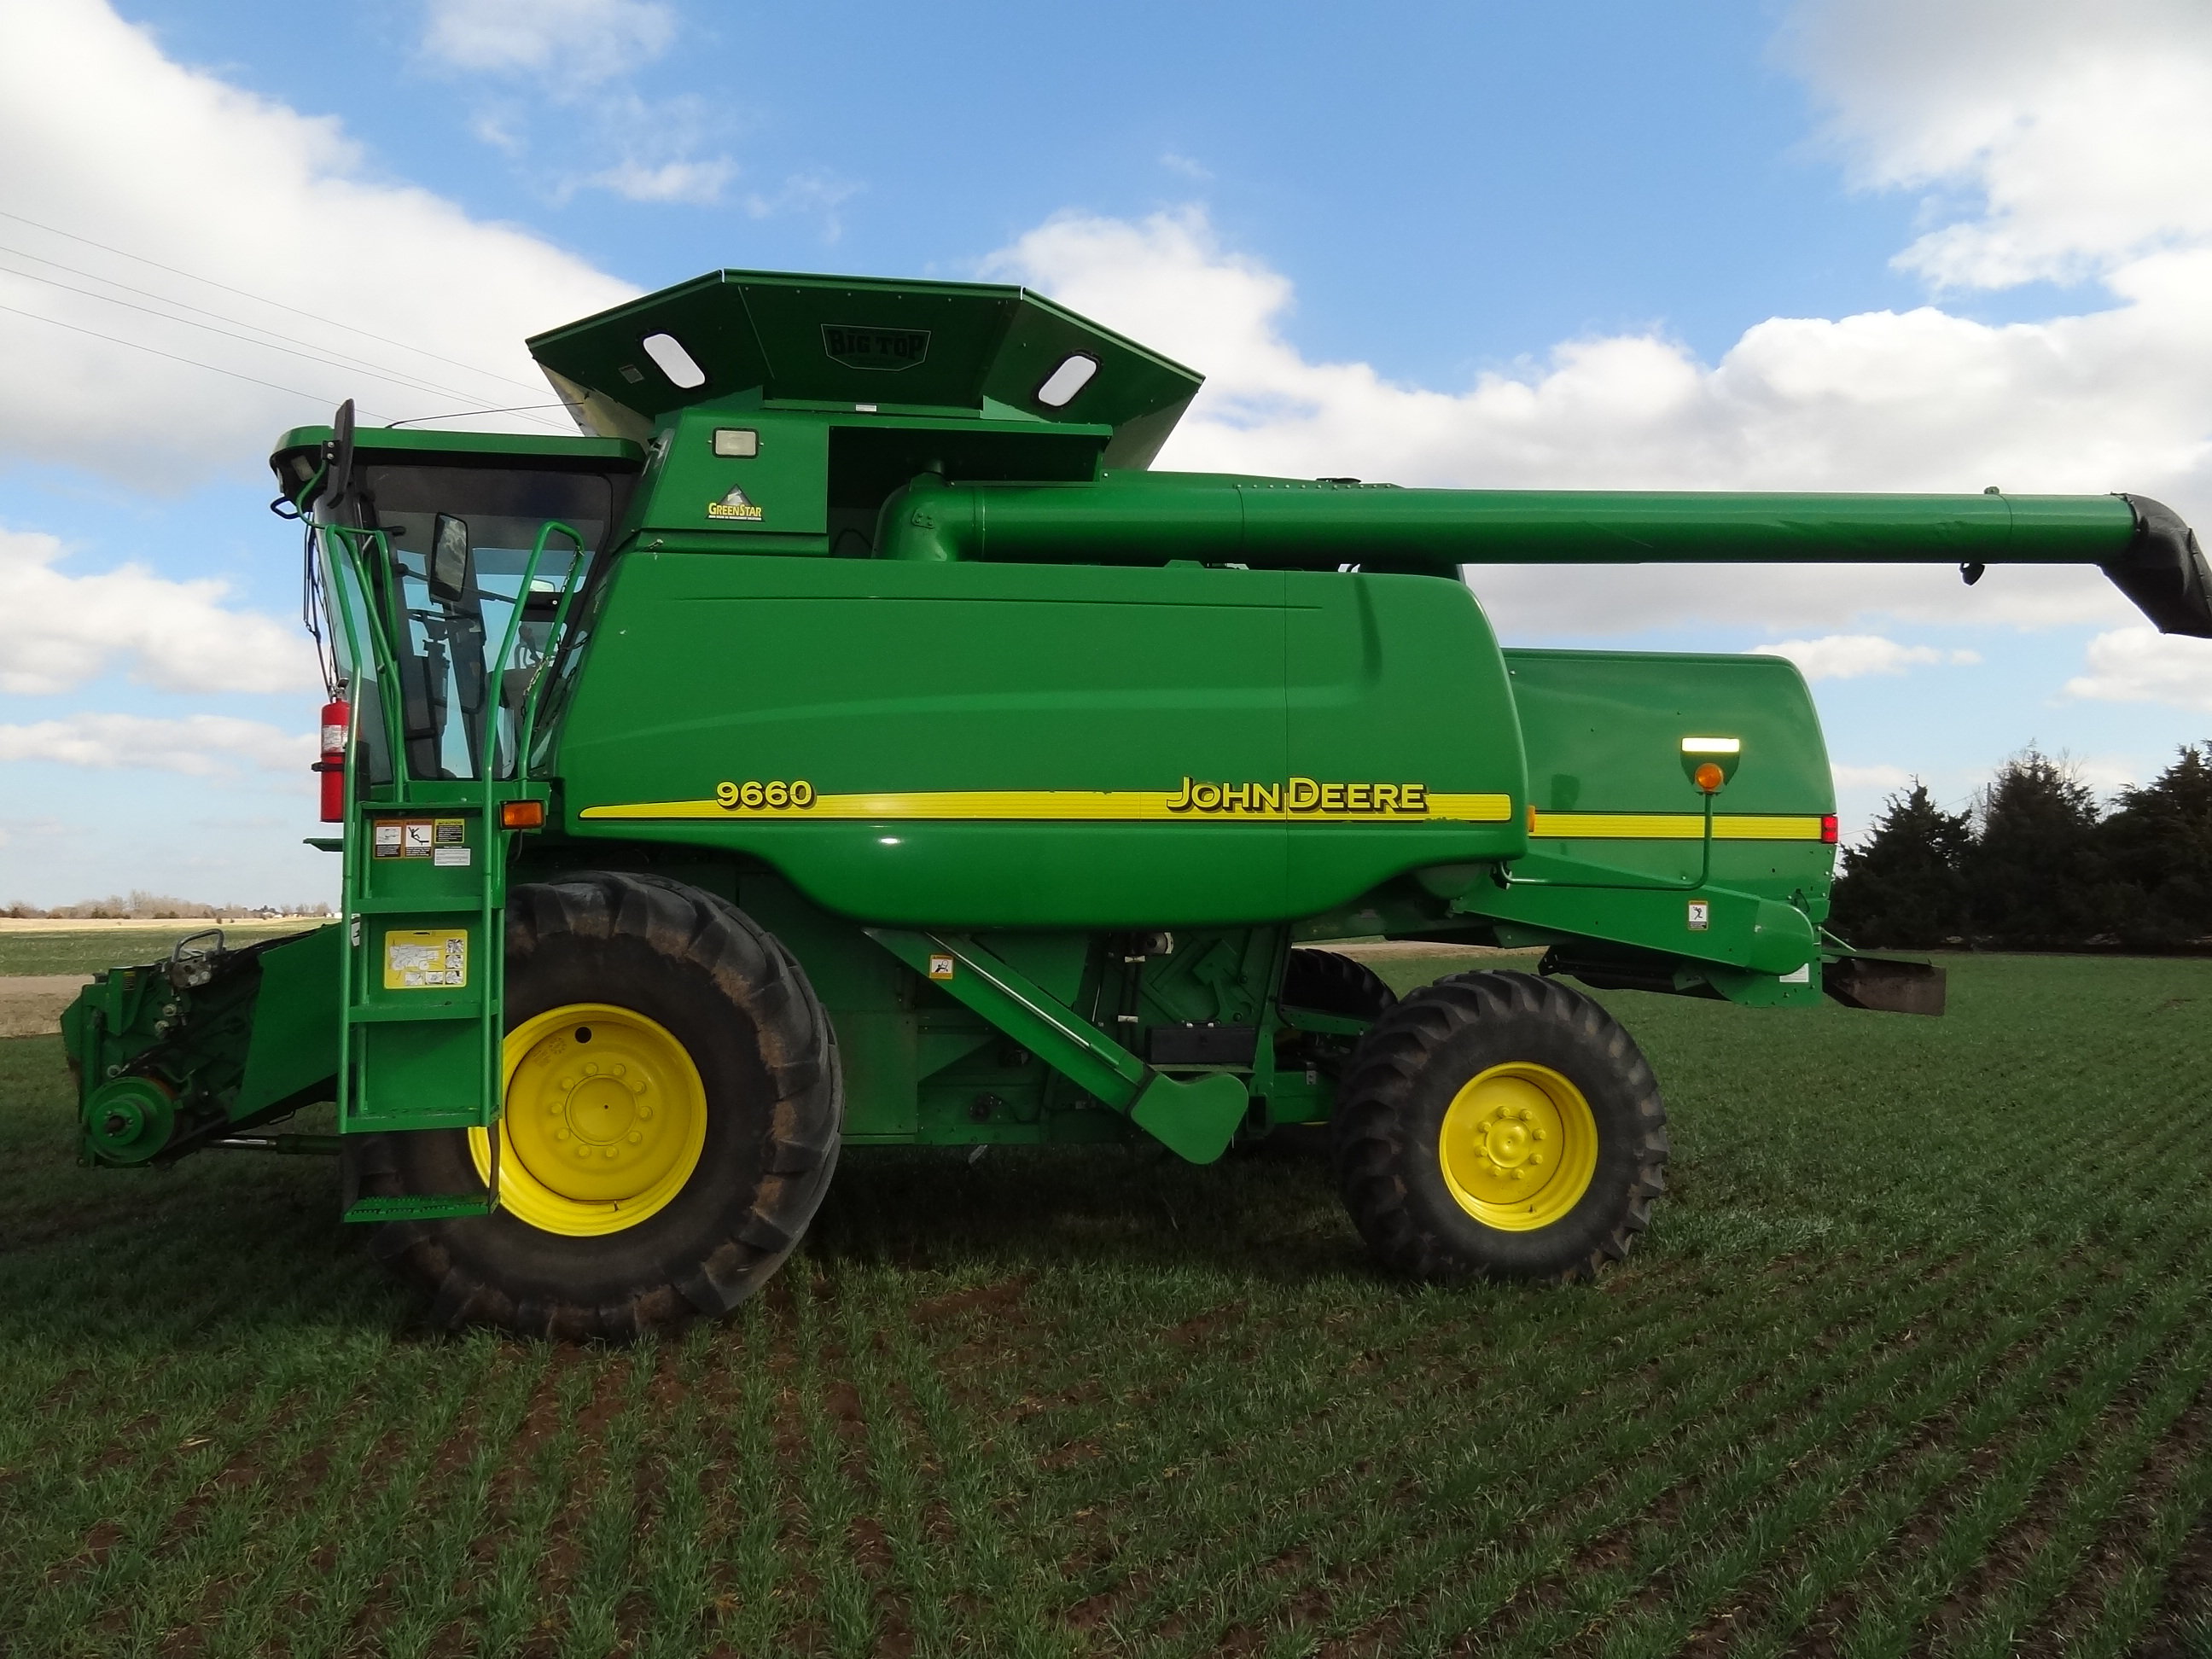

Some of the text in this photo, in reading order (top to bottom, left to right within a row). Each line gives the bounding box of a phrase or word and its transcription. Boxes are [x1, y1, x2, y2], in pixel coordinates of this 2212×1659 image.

[827, 329, 924, 360] BIG TOP
[716, 780, 815, 810] 9660
[1166, 776, 1427, 812] JOHN DEERE
